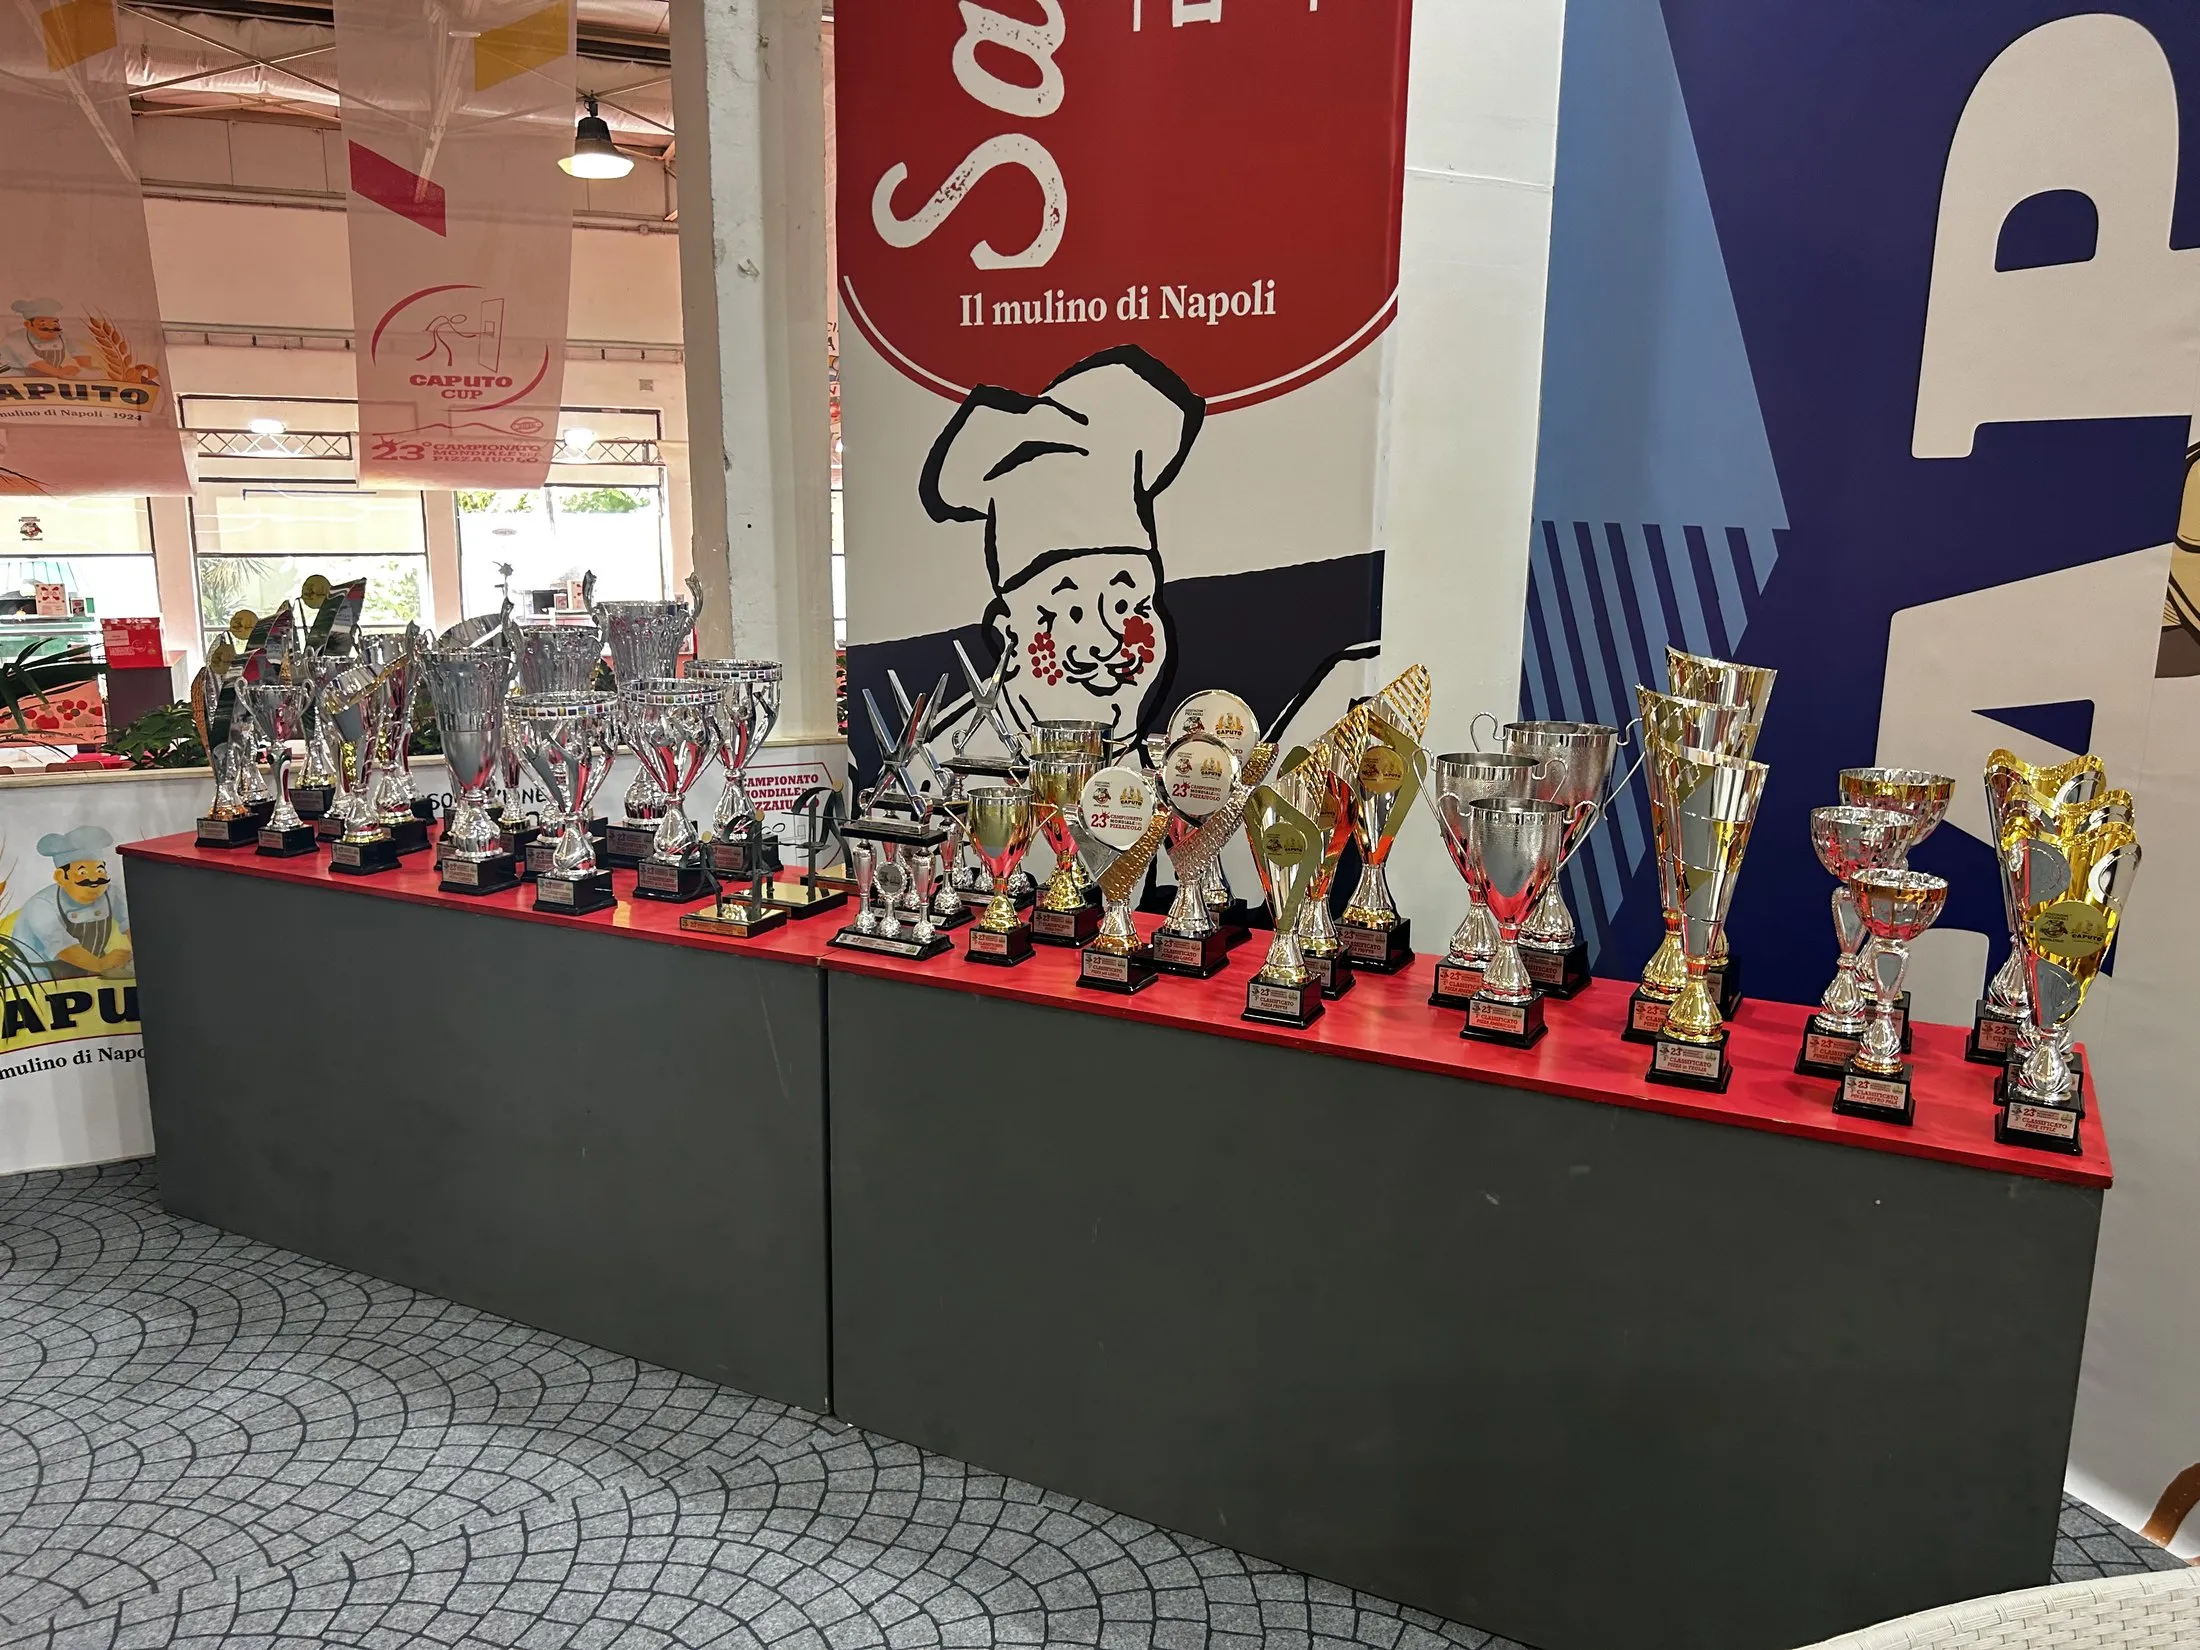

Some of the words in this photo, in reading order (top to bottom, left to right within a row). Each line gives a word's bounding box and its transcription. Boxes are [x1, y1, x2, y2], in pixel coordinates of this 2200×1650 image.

[960, 293, 984, 326] Il
[992, 290, 1108, 325] mulino
[1116, 286, 1150, 321] di
[1159, 280, 1276, 326] Napoli
[409, 374, 513, 388] CAPUTO
[440, 389, 483, 400] CUP
[43, 407, 58, 416] di
[60, 409, 103, 418] Napoli
[113, 412, 142, 421] 1924
[433, 443, 541, 451] CAMPIONATO
[1110, 814, 1143, 822] CAMPIONATO
[2071, 933, 2103, 941] CAPUTO
[72, 1049, 93, 1065] di
[1670, 1047, 1683, 1056] 23
[1669, 1056, 1712, 1068] CLASSIFICATO
[1856, 1089, 1899, 1101] CLASSIFICATO
[2023, 1107, 2036, 1117] 23
[2021, 1117, 2068, 1130] CLASSIFICATO
